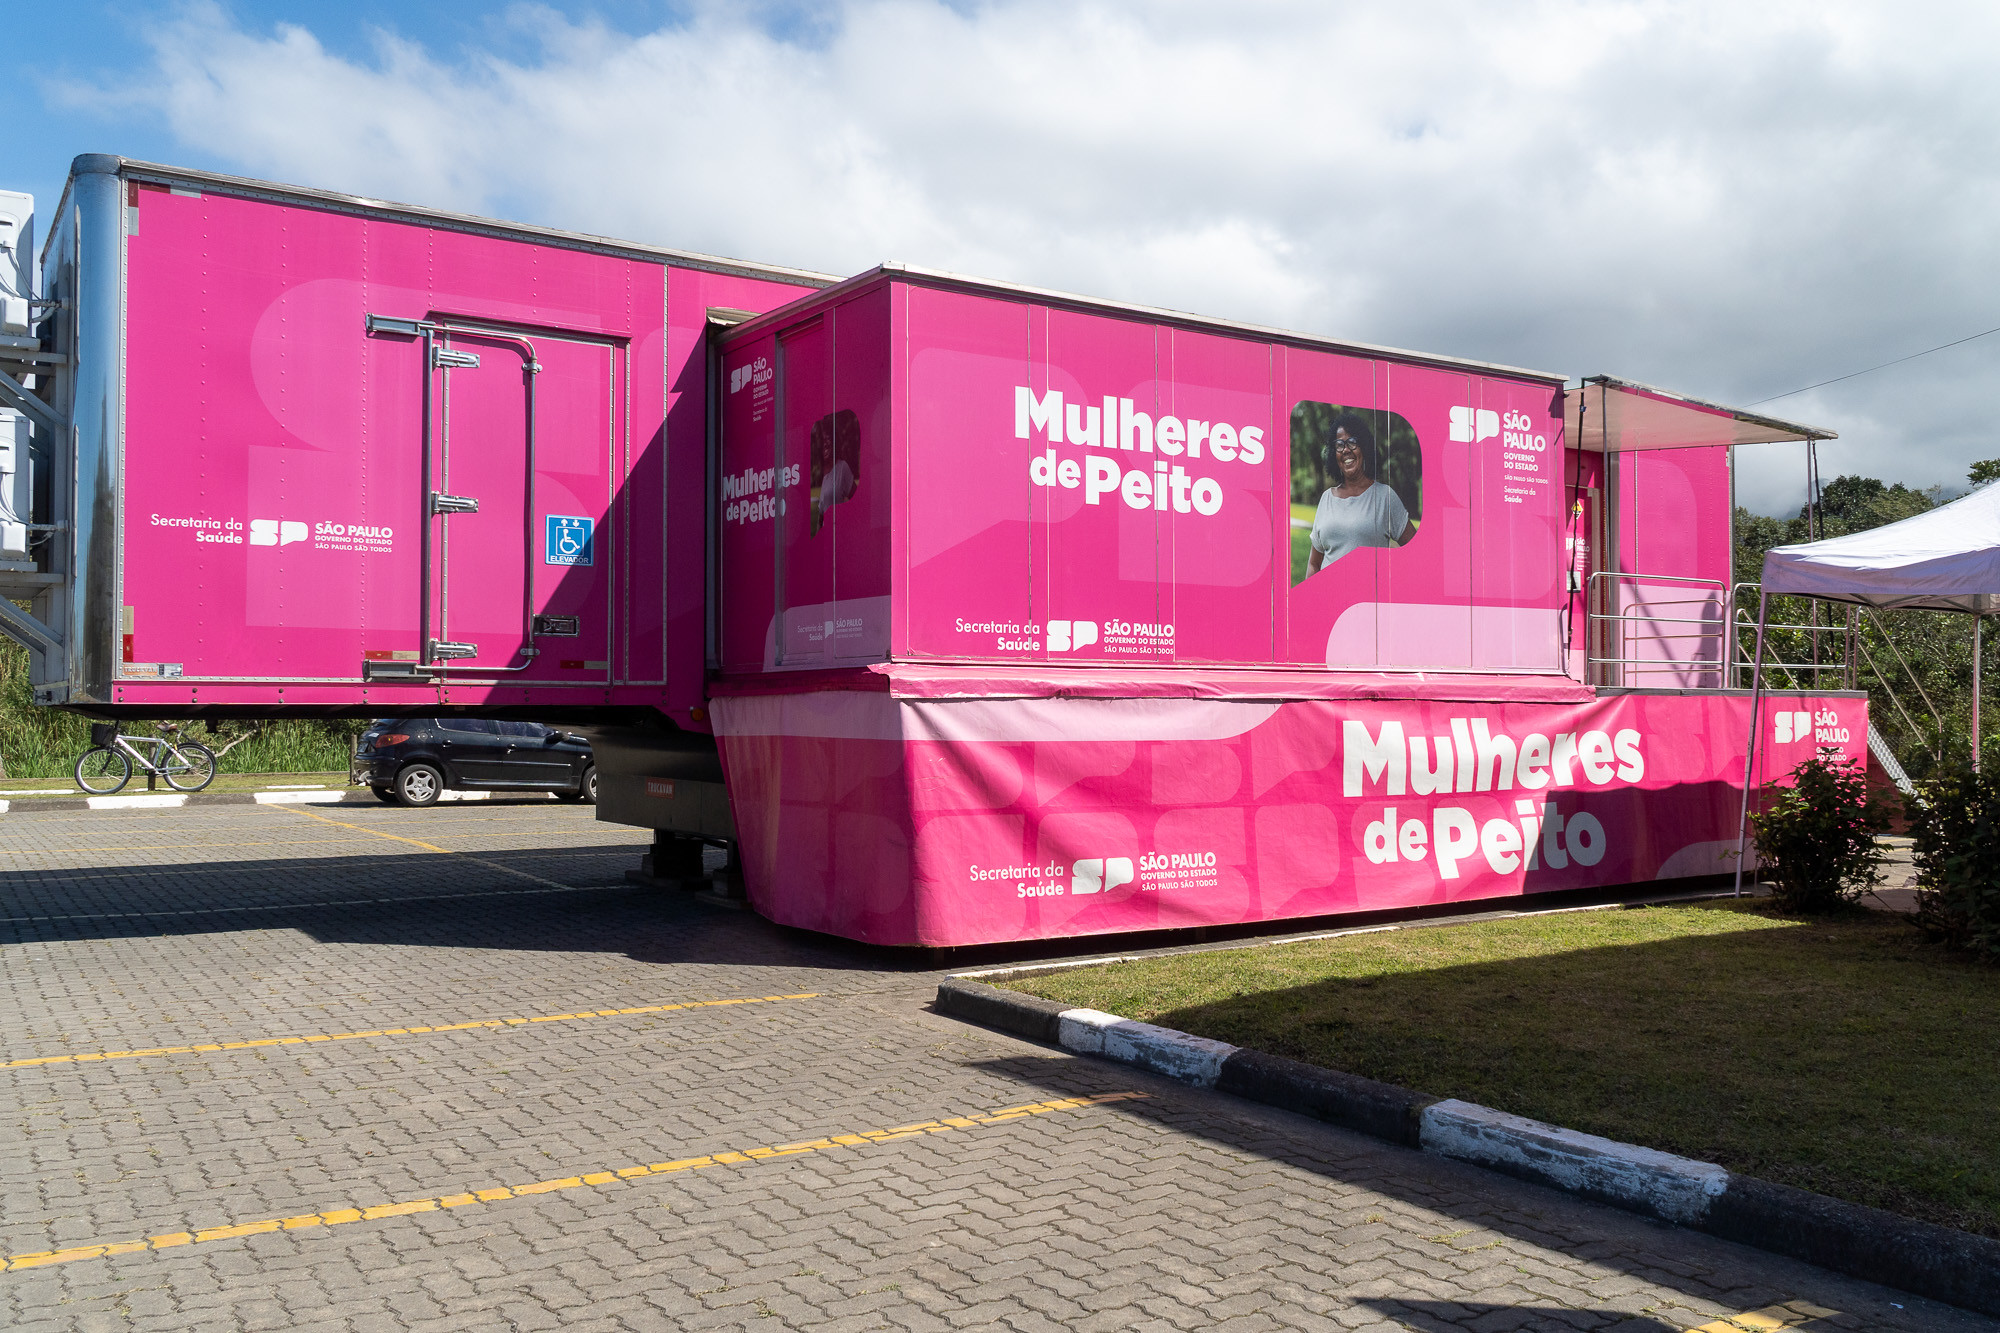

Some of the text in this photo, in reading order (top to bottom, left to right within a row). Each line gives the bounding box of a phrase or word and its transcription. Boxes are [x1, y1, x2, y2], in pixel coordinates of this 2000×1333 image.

[753, 357, 767, 373] SÃO
[753, 368, 773, 385] PAULO
[1014, 386, 1265, 464] Mulheres
[1449, 406, 1500, 444] SP
[1503, 409, 1531, 432] SÃO
[1503, 431, 1546, 452] PAULO
[1504, 452, 1535, 462] GOVERNO
[1504, 461, 1538, 472] DO ESTADO
[723, 464, 800, 501] Mulheres
[1030, 449, 1223, 516] de Peito
[1504, 494, 1523, 503] Saúde
[1529, 487, 1536, 496] da
[726, 495, 786, 525] de Peito
[150, 513, 243, 531] Secretaria da
[315, 521, 393, 538] SÃO PAULO
[196, 531, 243, 544] Saúde
[250, 519, 308, 546] SP
[315, 535, 351, 543] GOVERNO
[354, 544, 368, 552] SÃO
[550, 555, 589, 564] ELEVADOR
[956, 618, 1040, 634] Secretaria da
[1104, 619, 1174, 637] SÃO PAULO
[997, 637, 1040, 651] Saúde
[1047, 620, 1098, 651] SP
[1104, 636, 1137, 644] GOVERNO
[1150, 638, 1174, 646] ESTADO
[1104, 645, 1117, 653] SÃO
[1139, 646, 1152, 654] SÃO
[1815, 708, 1838, 726] SÃO
[1775, 712, 1811, 743] SP
[1815, 728, 1849, 743] PAULO
[1343, 718, 1644, 797] Mulheres
[1364, 799, 1606, 879] de Peito
[1140, 852, 1216, 871] SÃO PAULO
[970, 860, 1064, 881] Secretaria da
[1072, 857, 1134, 895] SP
[1141, 868, 1217, 881] GOVERNO DO ESTADO
[1017, 881, 1064, 898] Saúde
[1142, 878, 1218, 891] SÃO PAULO SÃO TODOS
